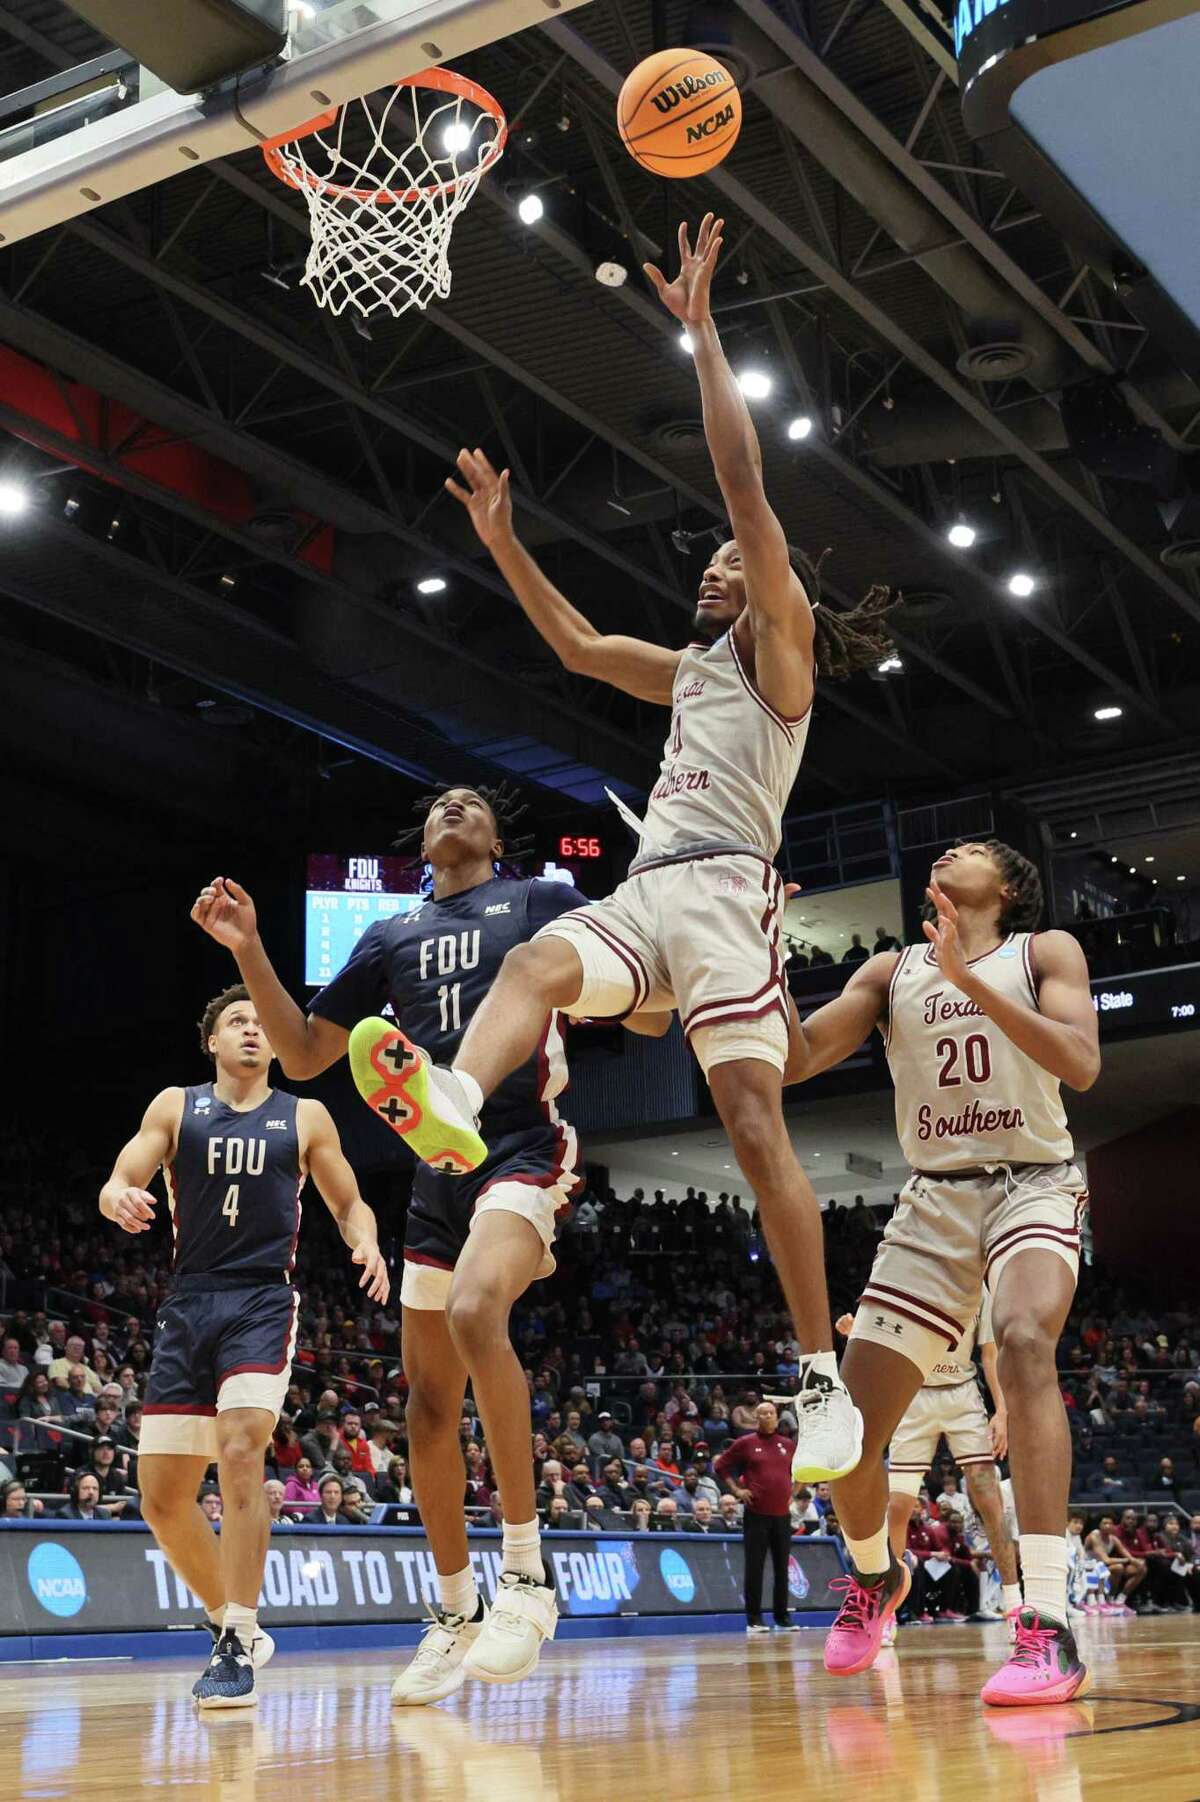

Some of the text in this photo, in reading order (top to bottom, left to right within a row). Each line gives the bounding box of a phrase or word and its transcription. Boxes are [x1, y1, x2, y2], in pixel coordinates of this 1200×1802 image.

[650, 70, 728, 113] Wilson
[686, 104, 735, 144] NCAA
[560, 838, 601, 857] 6:56
[348, 858, 379, 879] FDU
[484, 902, 511, 915] NEC
[420, 930, 481, 980] FDU
[438, 983, 461, 1032] 11
[924, 990, 985, 1025] Texa
[1100, 991, 1133, 1010] State
[1171, 1004, 1195, 1017] 7:00
[936, 1034, 991, 1088] 20
[265, 1120, 287, 1128] NEC
[918, 1099, 1025, 1141] Southern
[207, 1137, 267, 1176] FDU
[222, 1184, 240, 1227] 4
[37, 1578, 87, 1599] NCAA
[257, 1550, 339, 1607] OAD
[342, 1550, 393, 1606] TO
[394, 1551, 442, 1605] TH
[552, 1552, 633, 1601] FOUR
